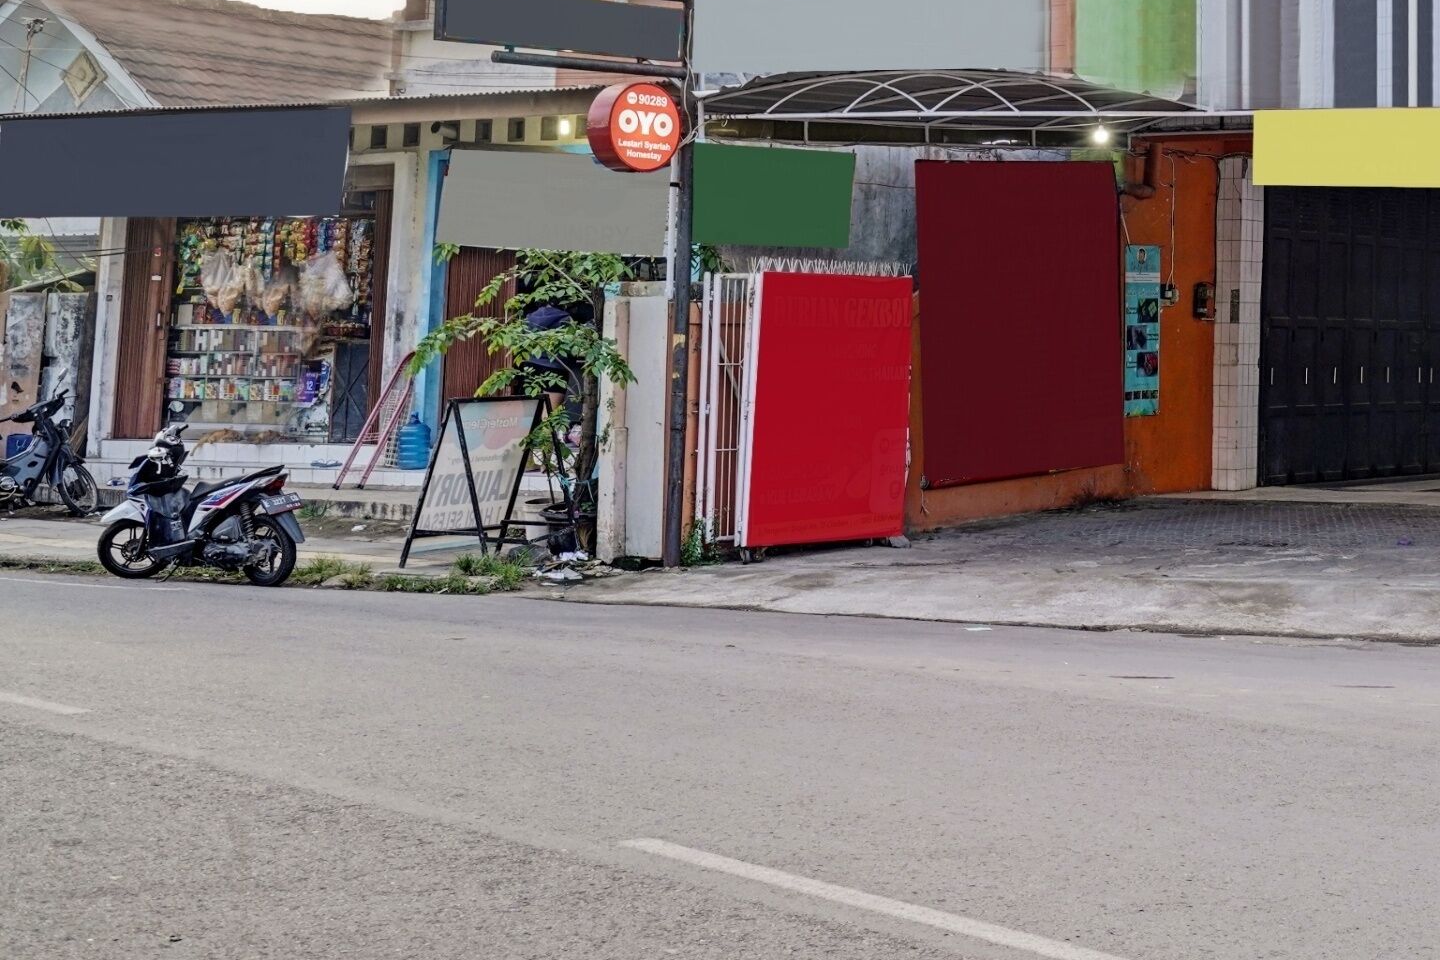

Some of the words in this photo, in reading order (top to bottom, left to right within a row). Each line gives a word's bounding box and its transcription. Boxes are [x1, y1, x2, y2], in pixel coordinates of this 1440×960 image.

[638, 94, 668, 108] 90289
[618, 109, 673, 137] OYO
[618, 138, 643, 149] Lestari
[644, 141, 672, 152] Syariah
[626, 149, 662, 162] Homestay
